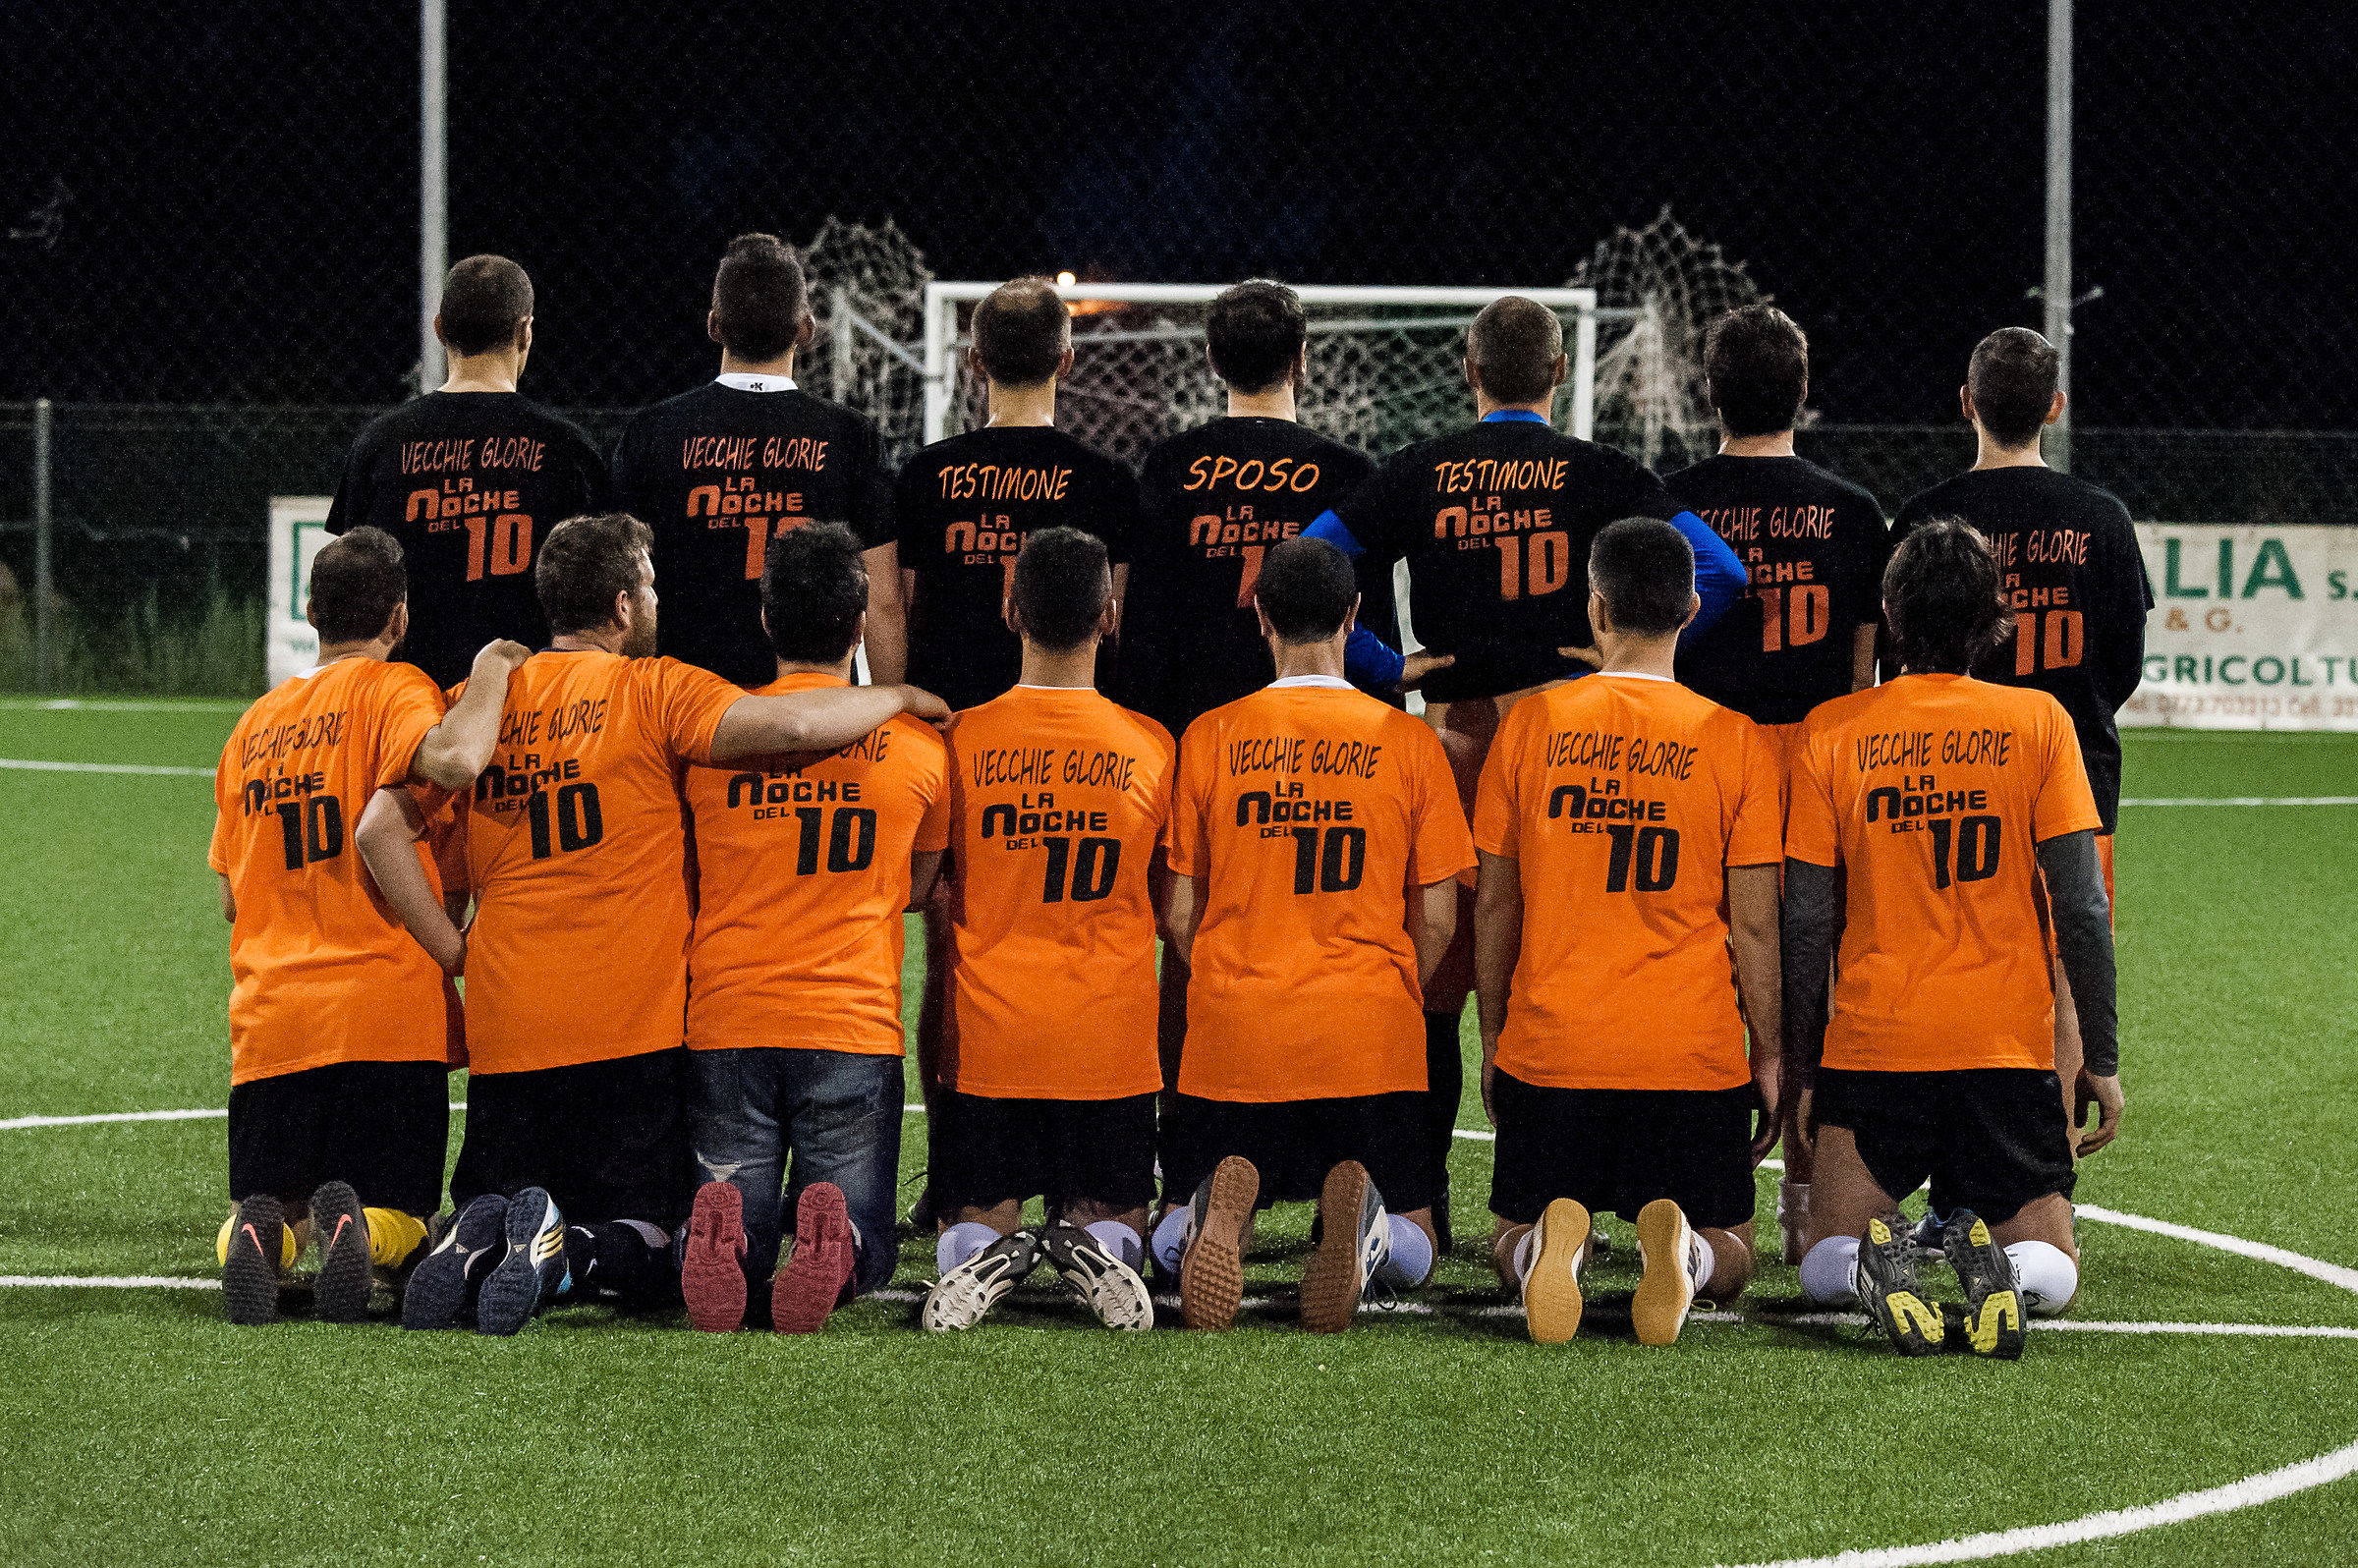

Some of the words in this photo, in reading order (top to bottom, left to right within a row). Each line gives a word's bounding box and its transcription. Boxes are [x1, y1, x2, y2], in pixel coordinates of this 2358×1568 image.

[402, 438, 475, 475] VECCHIE
[480, 435, 546, 472] GLORIE
[683, 436, 757, 470] VECCHIE
[762, 437, 829, 473] GLORIE
[444, 477, 474, 494] LA
[725, 476, 755, 492] LA
[937, 463, 1073, 501] TESTIMONE
[1183, 454, 1320, 493] SPOSO
[1434, 458, 1569, 494] TESTIMONE
[405, 489, 521, 522] NOCHE
[687, 483, 804, 517] NOCHE
[1225, 505, 1254, 522] LA
[1470, 495, 1502, 511] LA
[707, 517, 741, 530] DEL
[945, 522, 1028, 554] NOC
[981, 513, 1010, 530] LA
[1189, 515, 1301, 546] NOCHE
[1434, 506, 1553, 539] NOCHE
[1769, 505, 1835, 540] GLORIE
[427, 520, 462, 533] DEL
[465, 514, 533, 583] 10
[964, 553, 995, 566] DEL
[1206, 546, 1237, 558] DEL
[1456, 535, 1491, 551] DEL
[1493, 531, 1570, 600] 10
[2027, 529, 2092, 565] GLORIE
[2149, 536, 2306, 600] LIA
[2002, 587, 2070, 610] CHE
[1757, 585, 1830, 652] 10
[2164, 607, 2190, 632] &
[2015, 610, 2084, 677] 10
[547, 699, 607, 742] GLORIE
[509, 754, 541, 770] LA
[1229, 736, 1304, 778] VECCHIE
[1310, 737, 1383, 780] GLORIE
[1546, 732, 1625, 773] VECCHIE
[1627, 736, 1699, 781] GLORIE
[1857, 731, 1934, 773] VECCHIE
[1941, 728, 2012, 767] GLORIE
[973, 749, 1052, 790] VECCHIE
[1062, 750, 1137, 792] GLORIE
[1590, 776, 1621, 795] LA
[1903, 774, 1936, 793] LA
[727, 772, 862, 810] NOCHE
[1021, 792, 1054, 810] LA
[1235, 789, 1354, 828] NOCHE
[1274, 781, 1304, 799] LA
[1546, 783, 1667, 824] NOCHE
[1866, 786, 1988, 824] NOCHE
[277, 795, 344, 871] 10
[529, 782, 604, 860] 10
[981, 803, 1108, 839] NOCHE
[754, 806, 791, 820] DEL
[795, 807, 877, 876] 10
[1571, 821, 1604, 835] DEL
[1603, 823, 1680, 894] 10
[1890, 819, 1926, 835] DEL
[1928, 814, 2002, 890] 10
[1006, 835, 1042, 851] DEL
[1041, 836, 1122, 904] 10
[1259, 825, 1292, 839] DEL
[1291, 825, 1367, 895] 10
